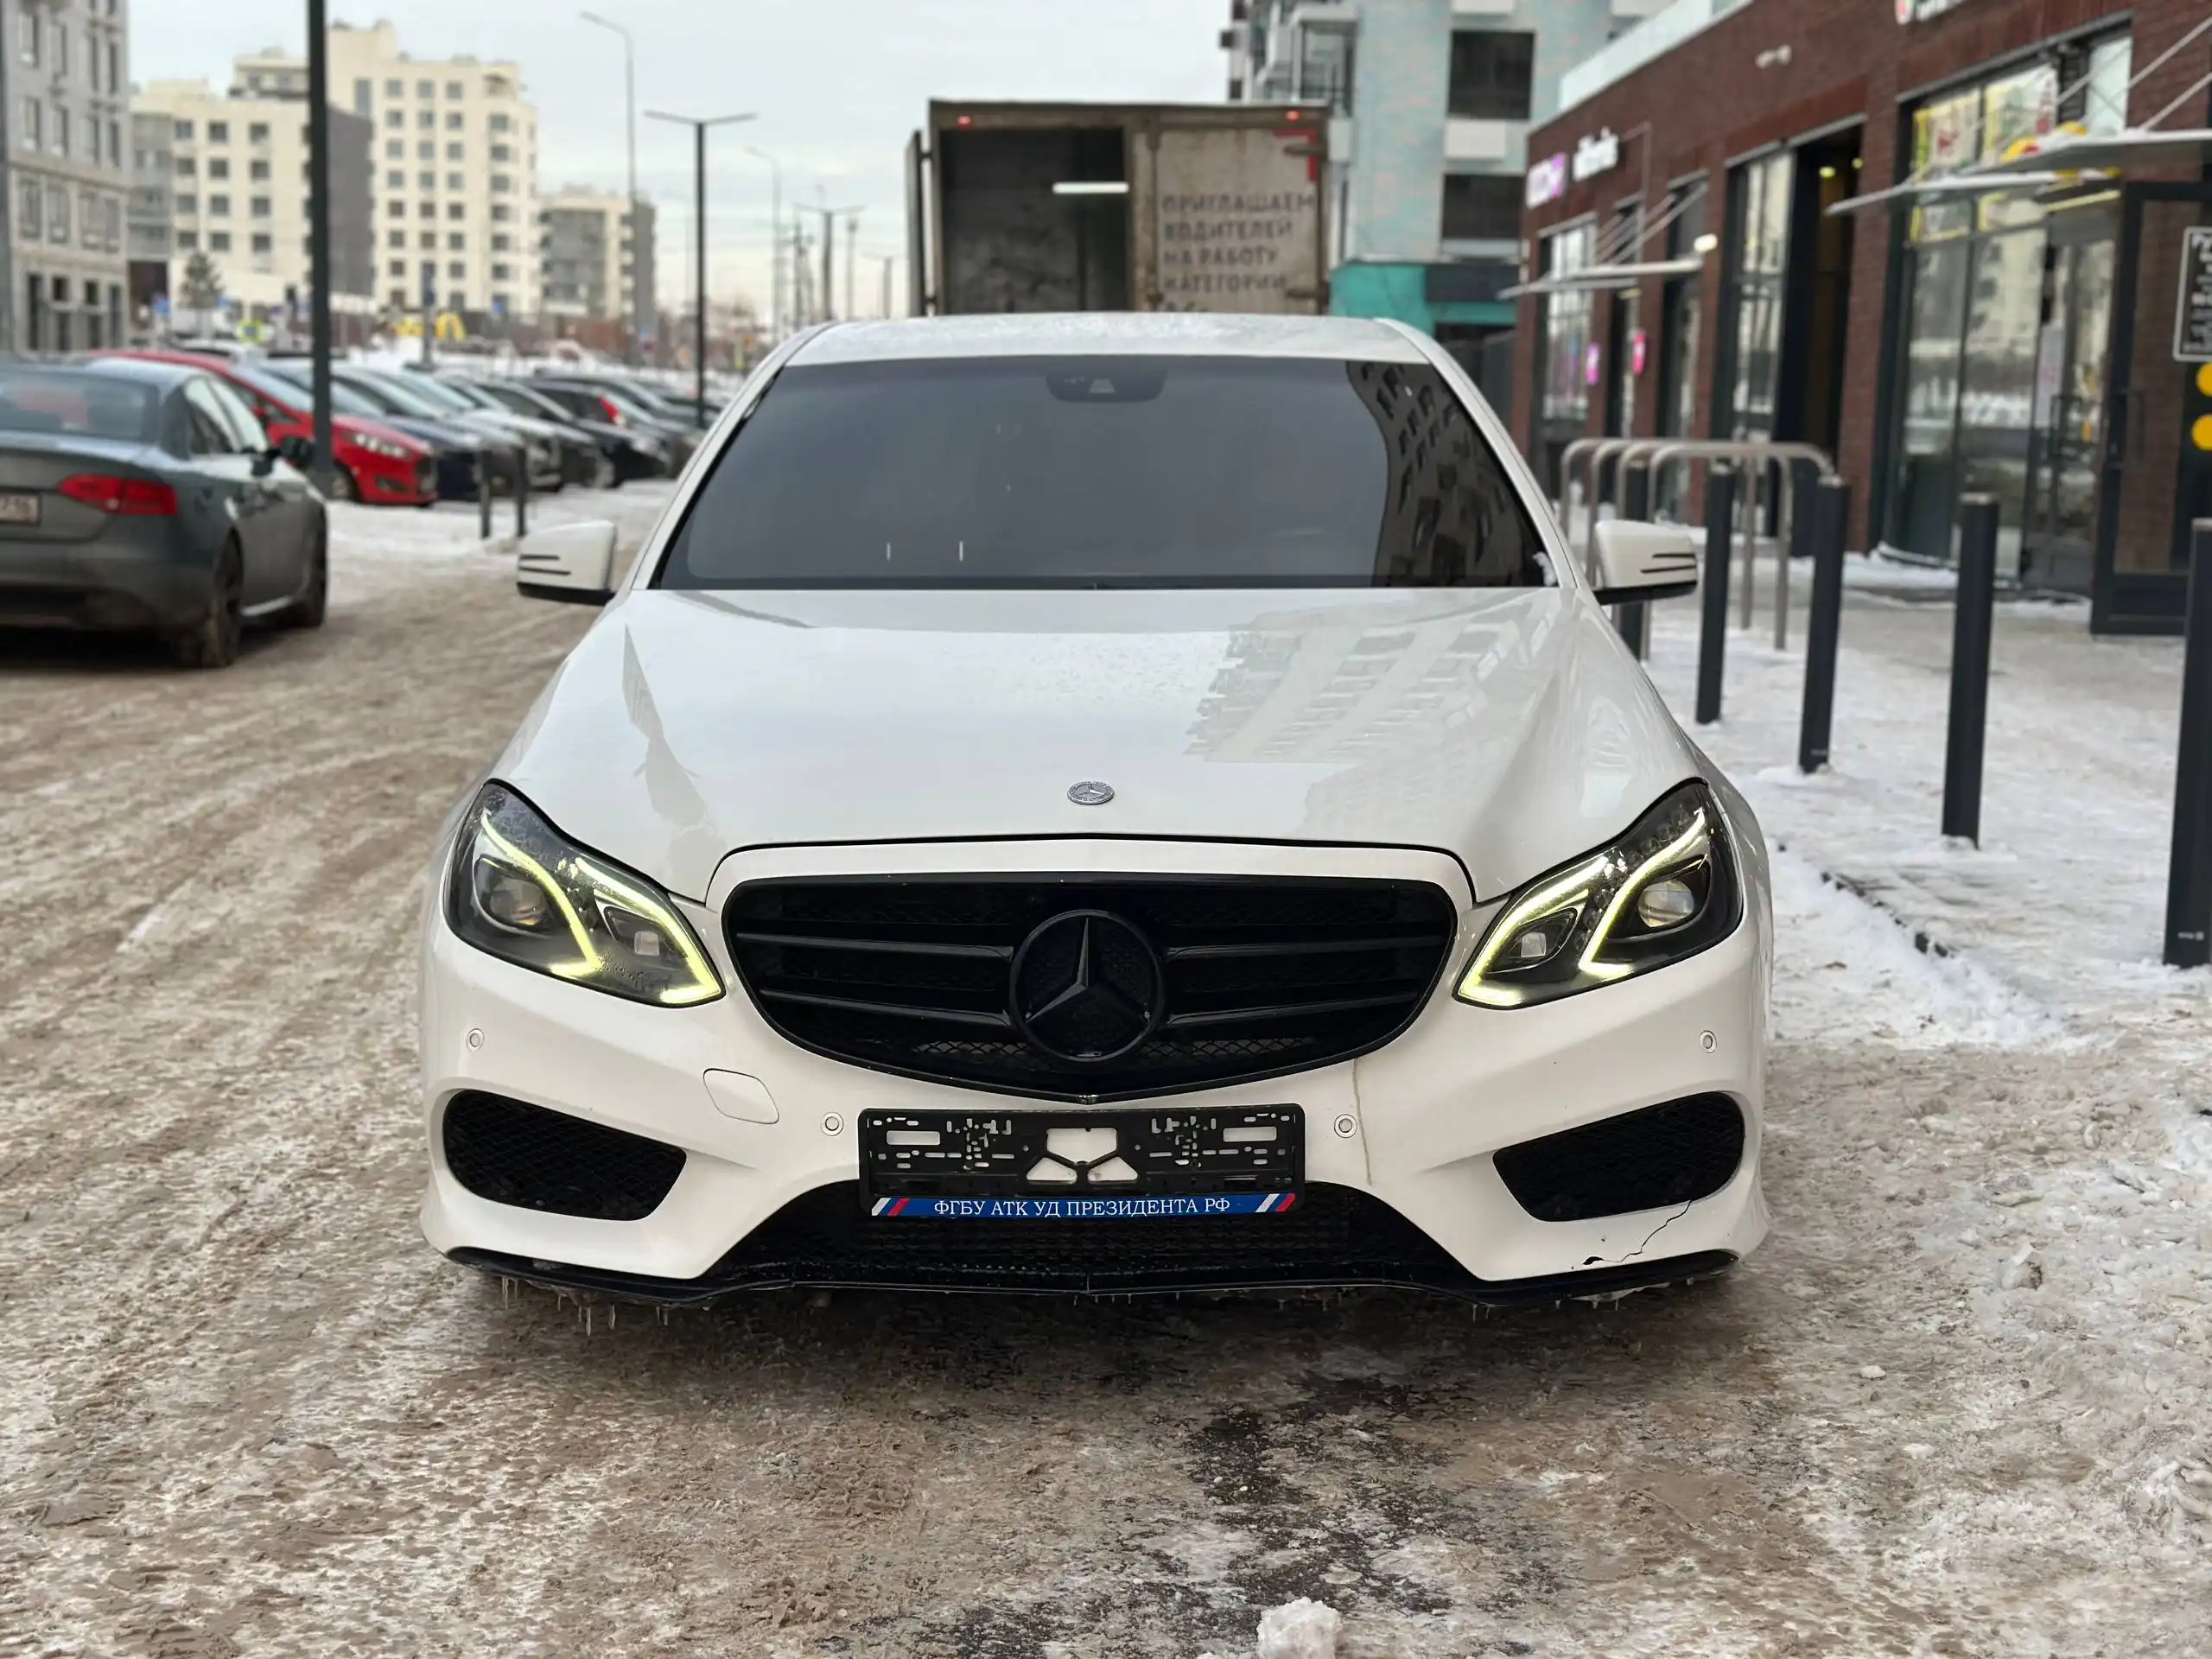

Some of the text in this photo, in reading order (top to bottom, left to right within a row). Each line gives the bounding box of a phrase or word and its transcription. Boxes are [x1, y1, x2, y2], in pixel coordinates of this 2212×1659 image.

[1163, 245, 1278, 264] НА РАБОТУ
[934, 1197, 1230, 1217] ФГБУ АТК УД ПРЕЗИДЕНТА РФ
